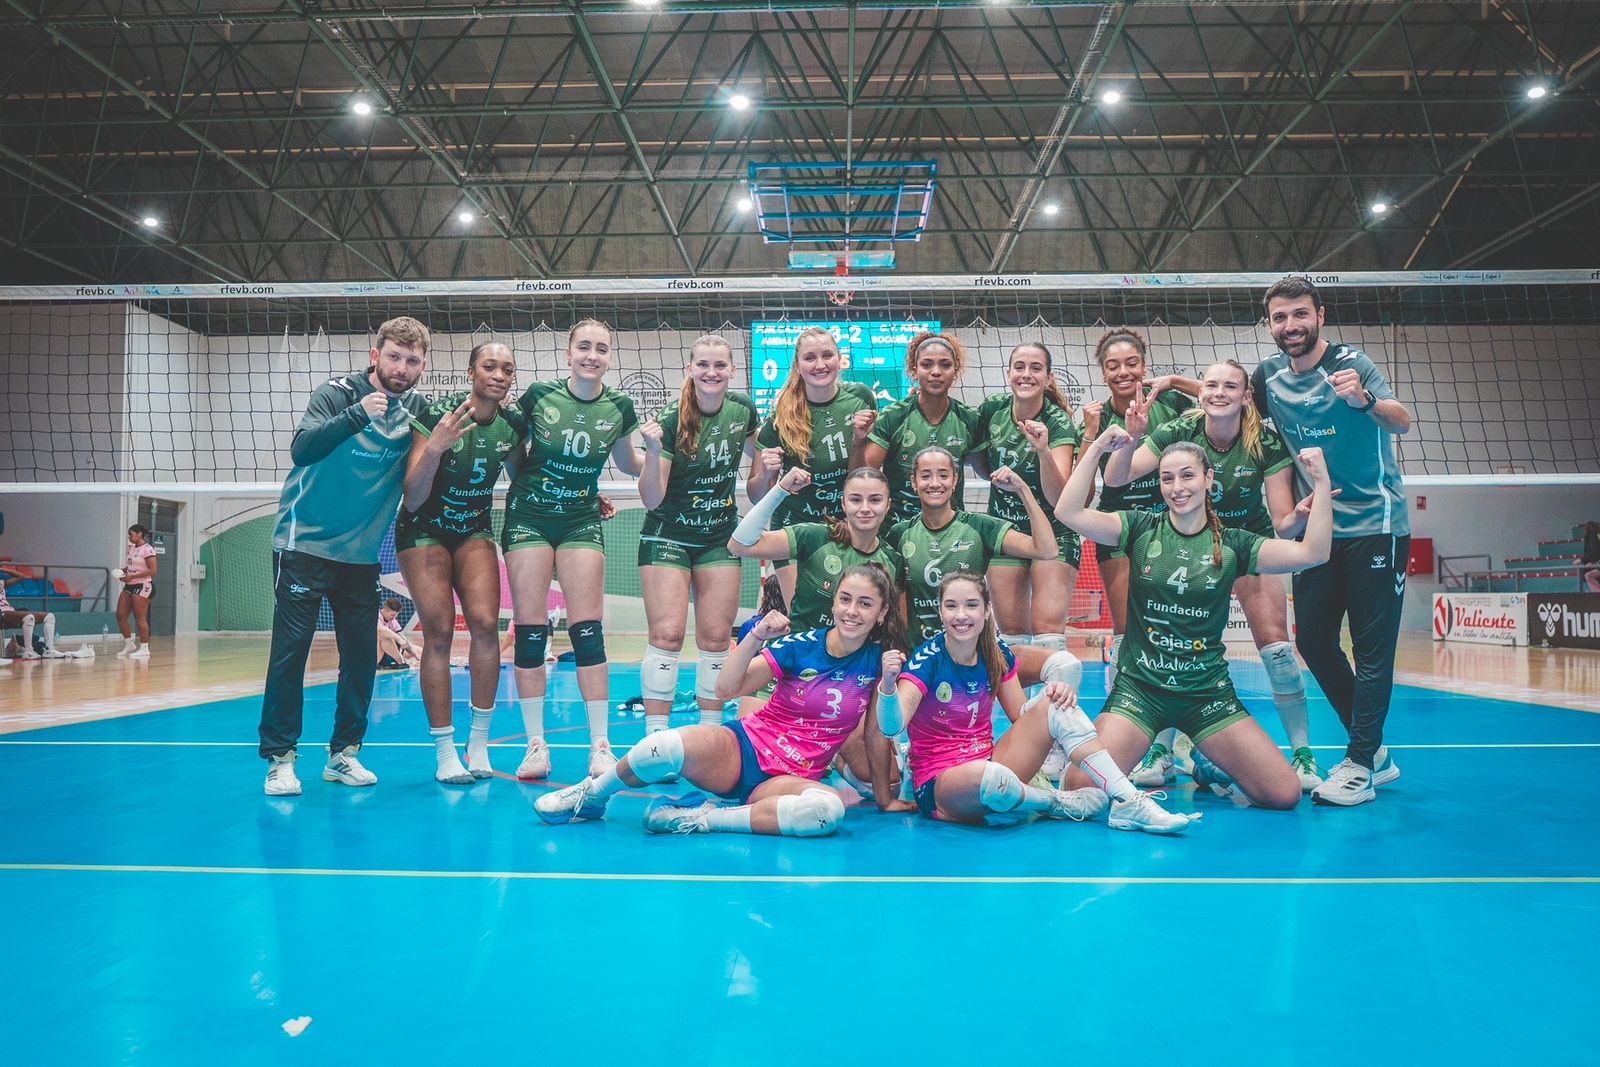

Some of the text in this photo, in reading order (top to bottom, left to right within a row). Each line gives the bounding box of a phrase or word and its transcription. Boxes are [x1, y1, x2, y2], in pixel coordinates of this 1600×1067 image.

[76, 286, 115, 296] rfevb.c
[220, 284, 274, 294] rfevb.com
[516, 281, 572, 291] rfevb.com
[667, 280, 724, 289] rfevb.com
[974, 276, 1031, 286] rfevb.com
[762, 359, 778, 381] 0
[561, 428, 591, 458] 10
[1303, 425, 1336, 439] Cajasol
[704, 439, 732, 469] 14
[821, 431, 848, 462] 11
[469, 457, 488, 484] 5
[814, 468, 847, 481] Funda
[449, 486, 494, 497] Fundació
[542, 478, 590, 499] Cajasol
[815, 488, 844, 503] Caja
[1208, 479, 1224, 503] 9
[924, 558, 942, 588] 6
[1166, 566, 1189, 595] 4
[1146, 599, 1210, 619] Fundación
[1455, 606, 1517, 630] Valiente
[1562, 603, 1600, 639] hum
[1148, 627, 1207, 652] Cajasol
[1135, 650, 1207, 672] Andalucía
[819, 687, 843, 719] 3
[775, 735, 815, 770] Cajasol
